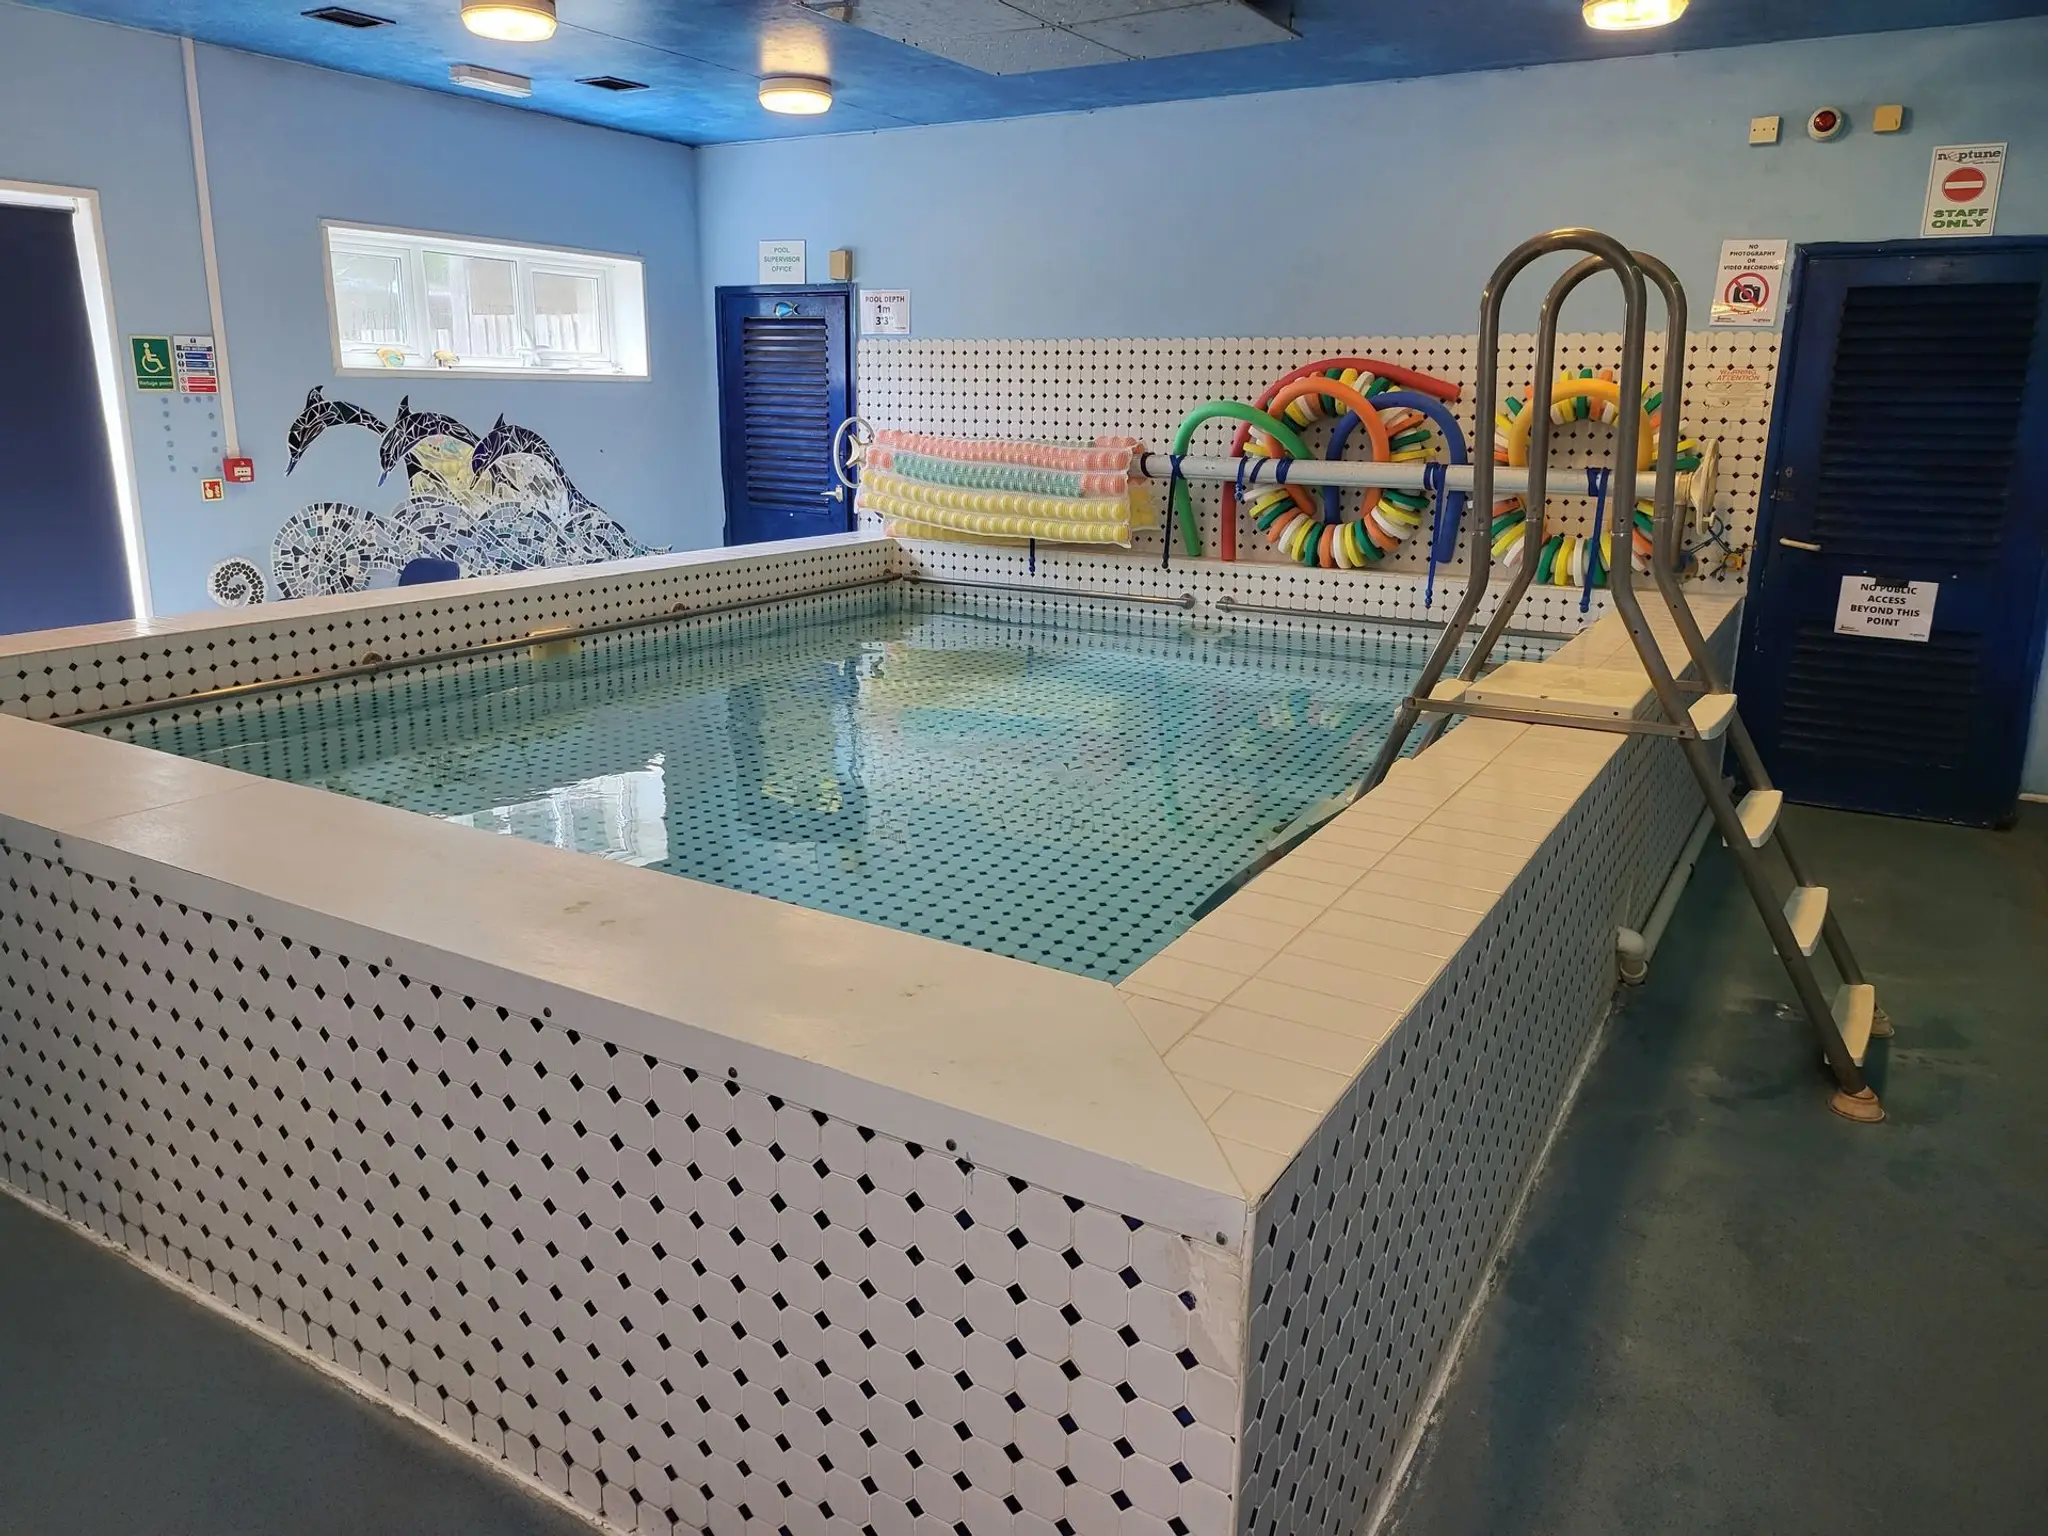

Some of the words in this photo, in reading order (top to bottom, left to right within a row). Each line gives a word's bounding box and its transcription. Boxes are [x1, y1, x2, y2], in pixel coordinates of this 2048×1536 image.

[1938, 150, 2001, 162] neptune
[1933, 208, 1989, 218] STAFF
[1931, 219, 1987, 228] ONLY
[877, 305, 890, 313] 1m
[1860, 583, 1877, 591] NO
[1880, 585, 1918, 595] PUBLIC
[1867, 595, 1906, 605] ACCESS
[1850, 604, 1894, 615] BEYOND
[1897, 609, 1920, 617] THIS
[1866, 617, 1900, 626] POINT
